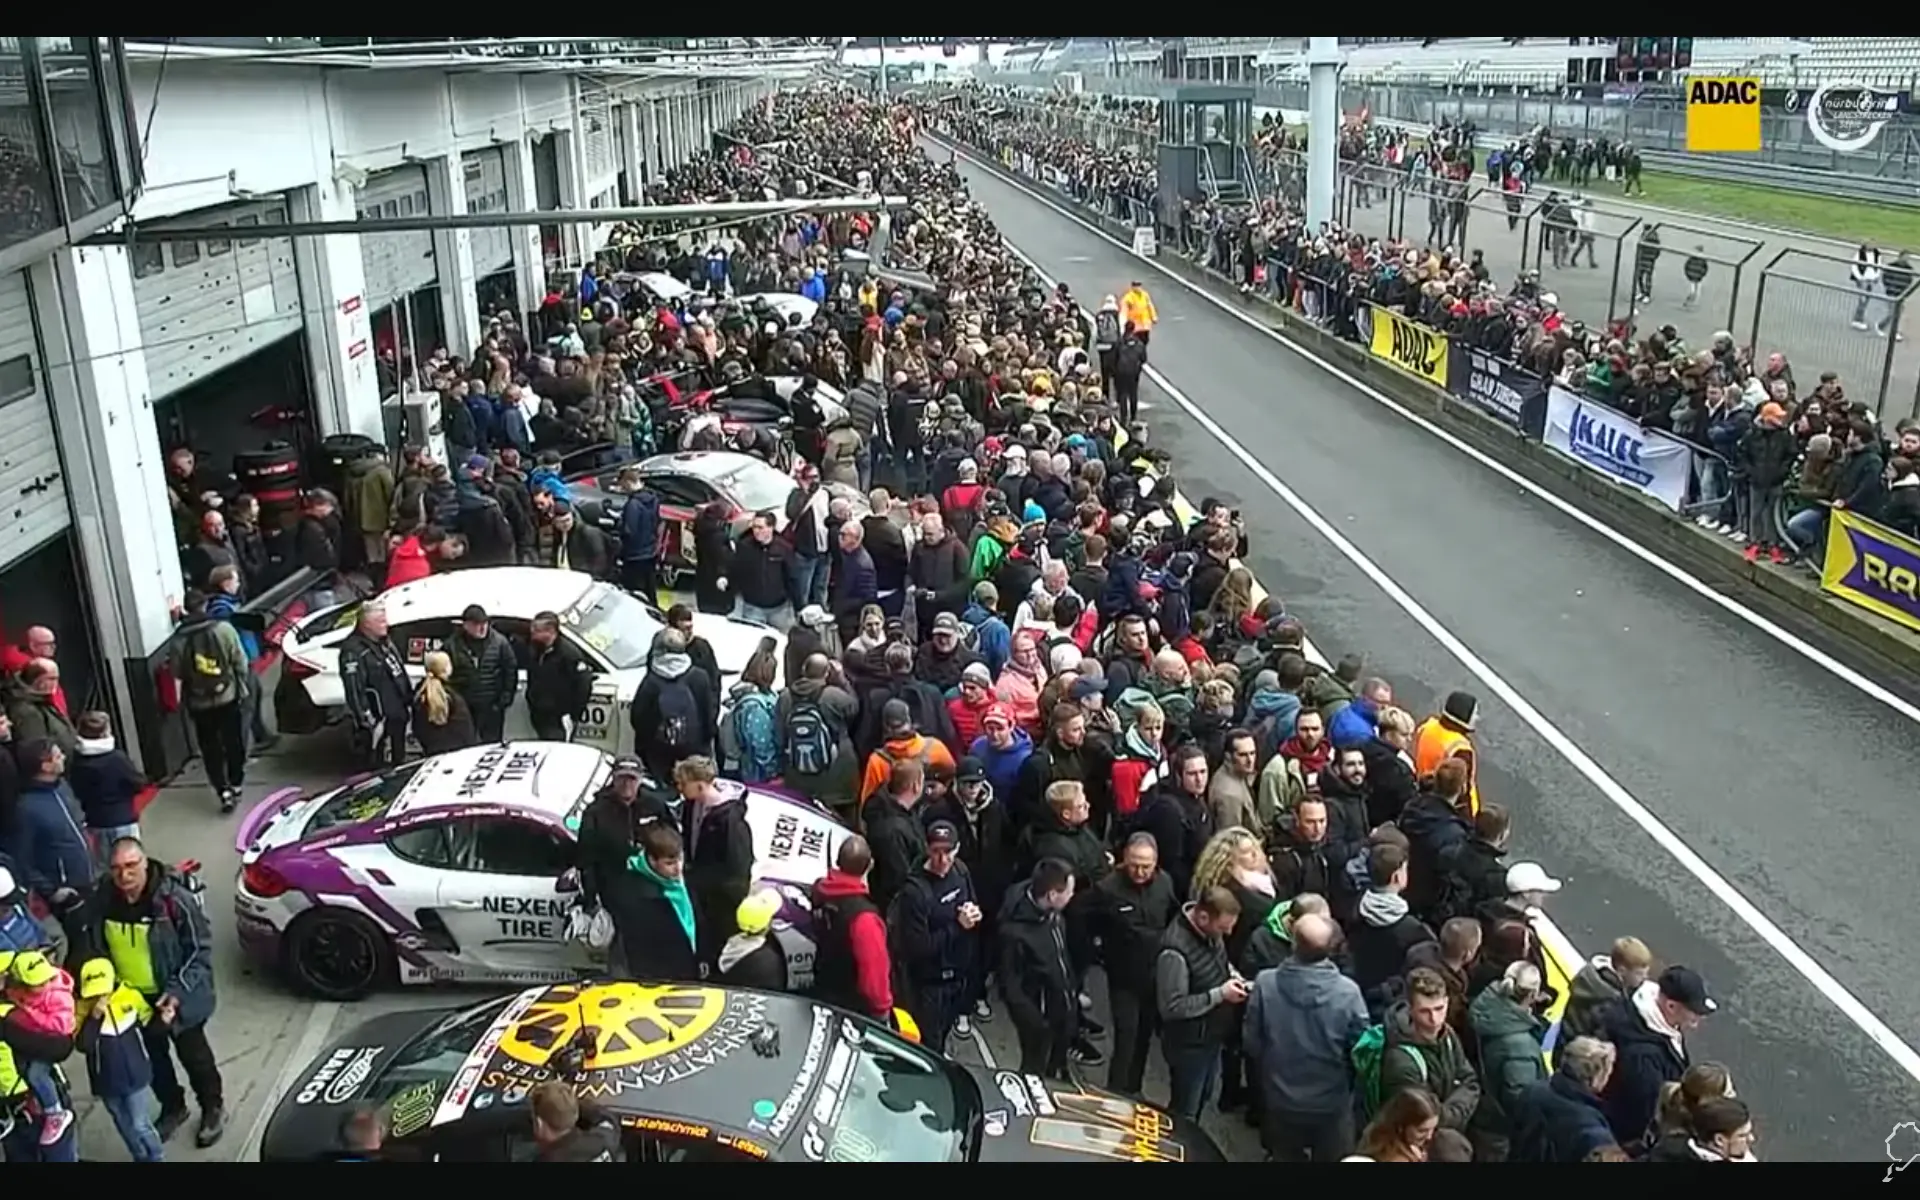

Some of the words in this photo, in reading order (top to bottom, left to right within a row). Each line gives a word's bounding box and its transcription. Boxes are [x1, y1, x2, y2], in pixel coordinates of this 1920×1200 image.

[1391, 318, 1435, 375] ADAC
[1863, 552, 1920, 602] RA
[768, 813, 799, 861] NEXEN
[798, 826, 824, 859] TIRE
[482, 896, 565, 918] NEXEN
[497, 918, 552, 938] TIRE
[297, 1049, 355, 1104] BAHCO
